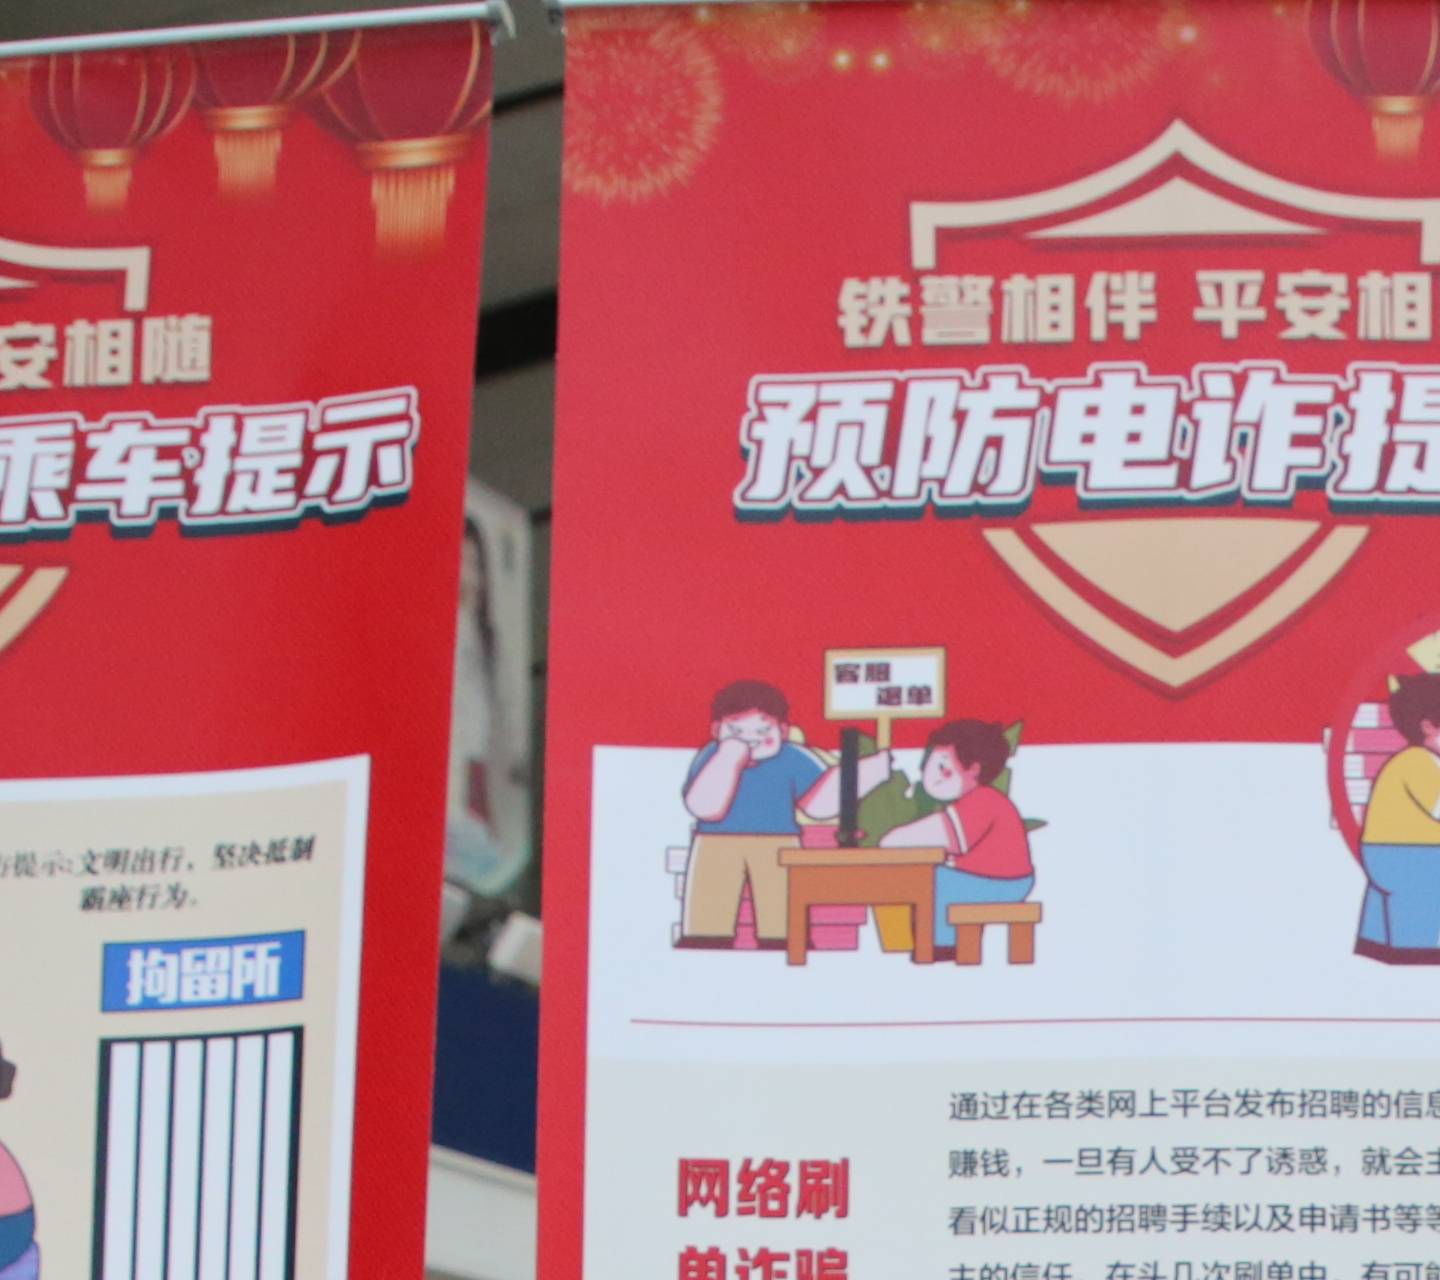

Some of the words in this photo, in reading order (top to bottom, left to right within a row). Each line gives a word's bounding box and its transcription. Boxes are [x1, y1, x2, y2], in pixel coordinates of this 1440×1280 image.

[837, 269, 1158, 350] 铁警相伴
[126, 942, 281, 1005] 拘留所
[677, 1156, 850, 1220] 网络刷
